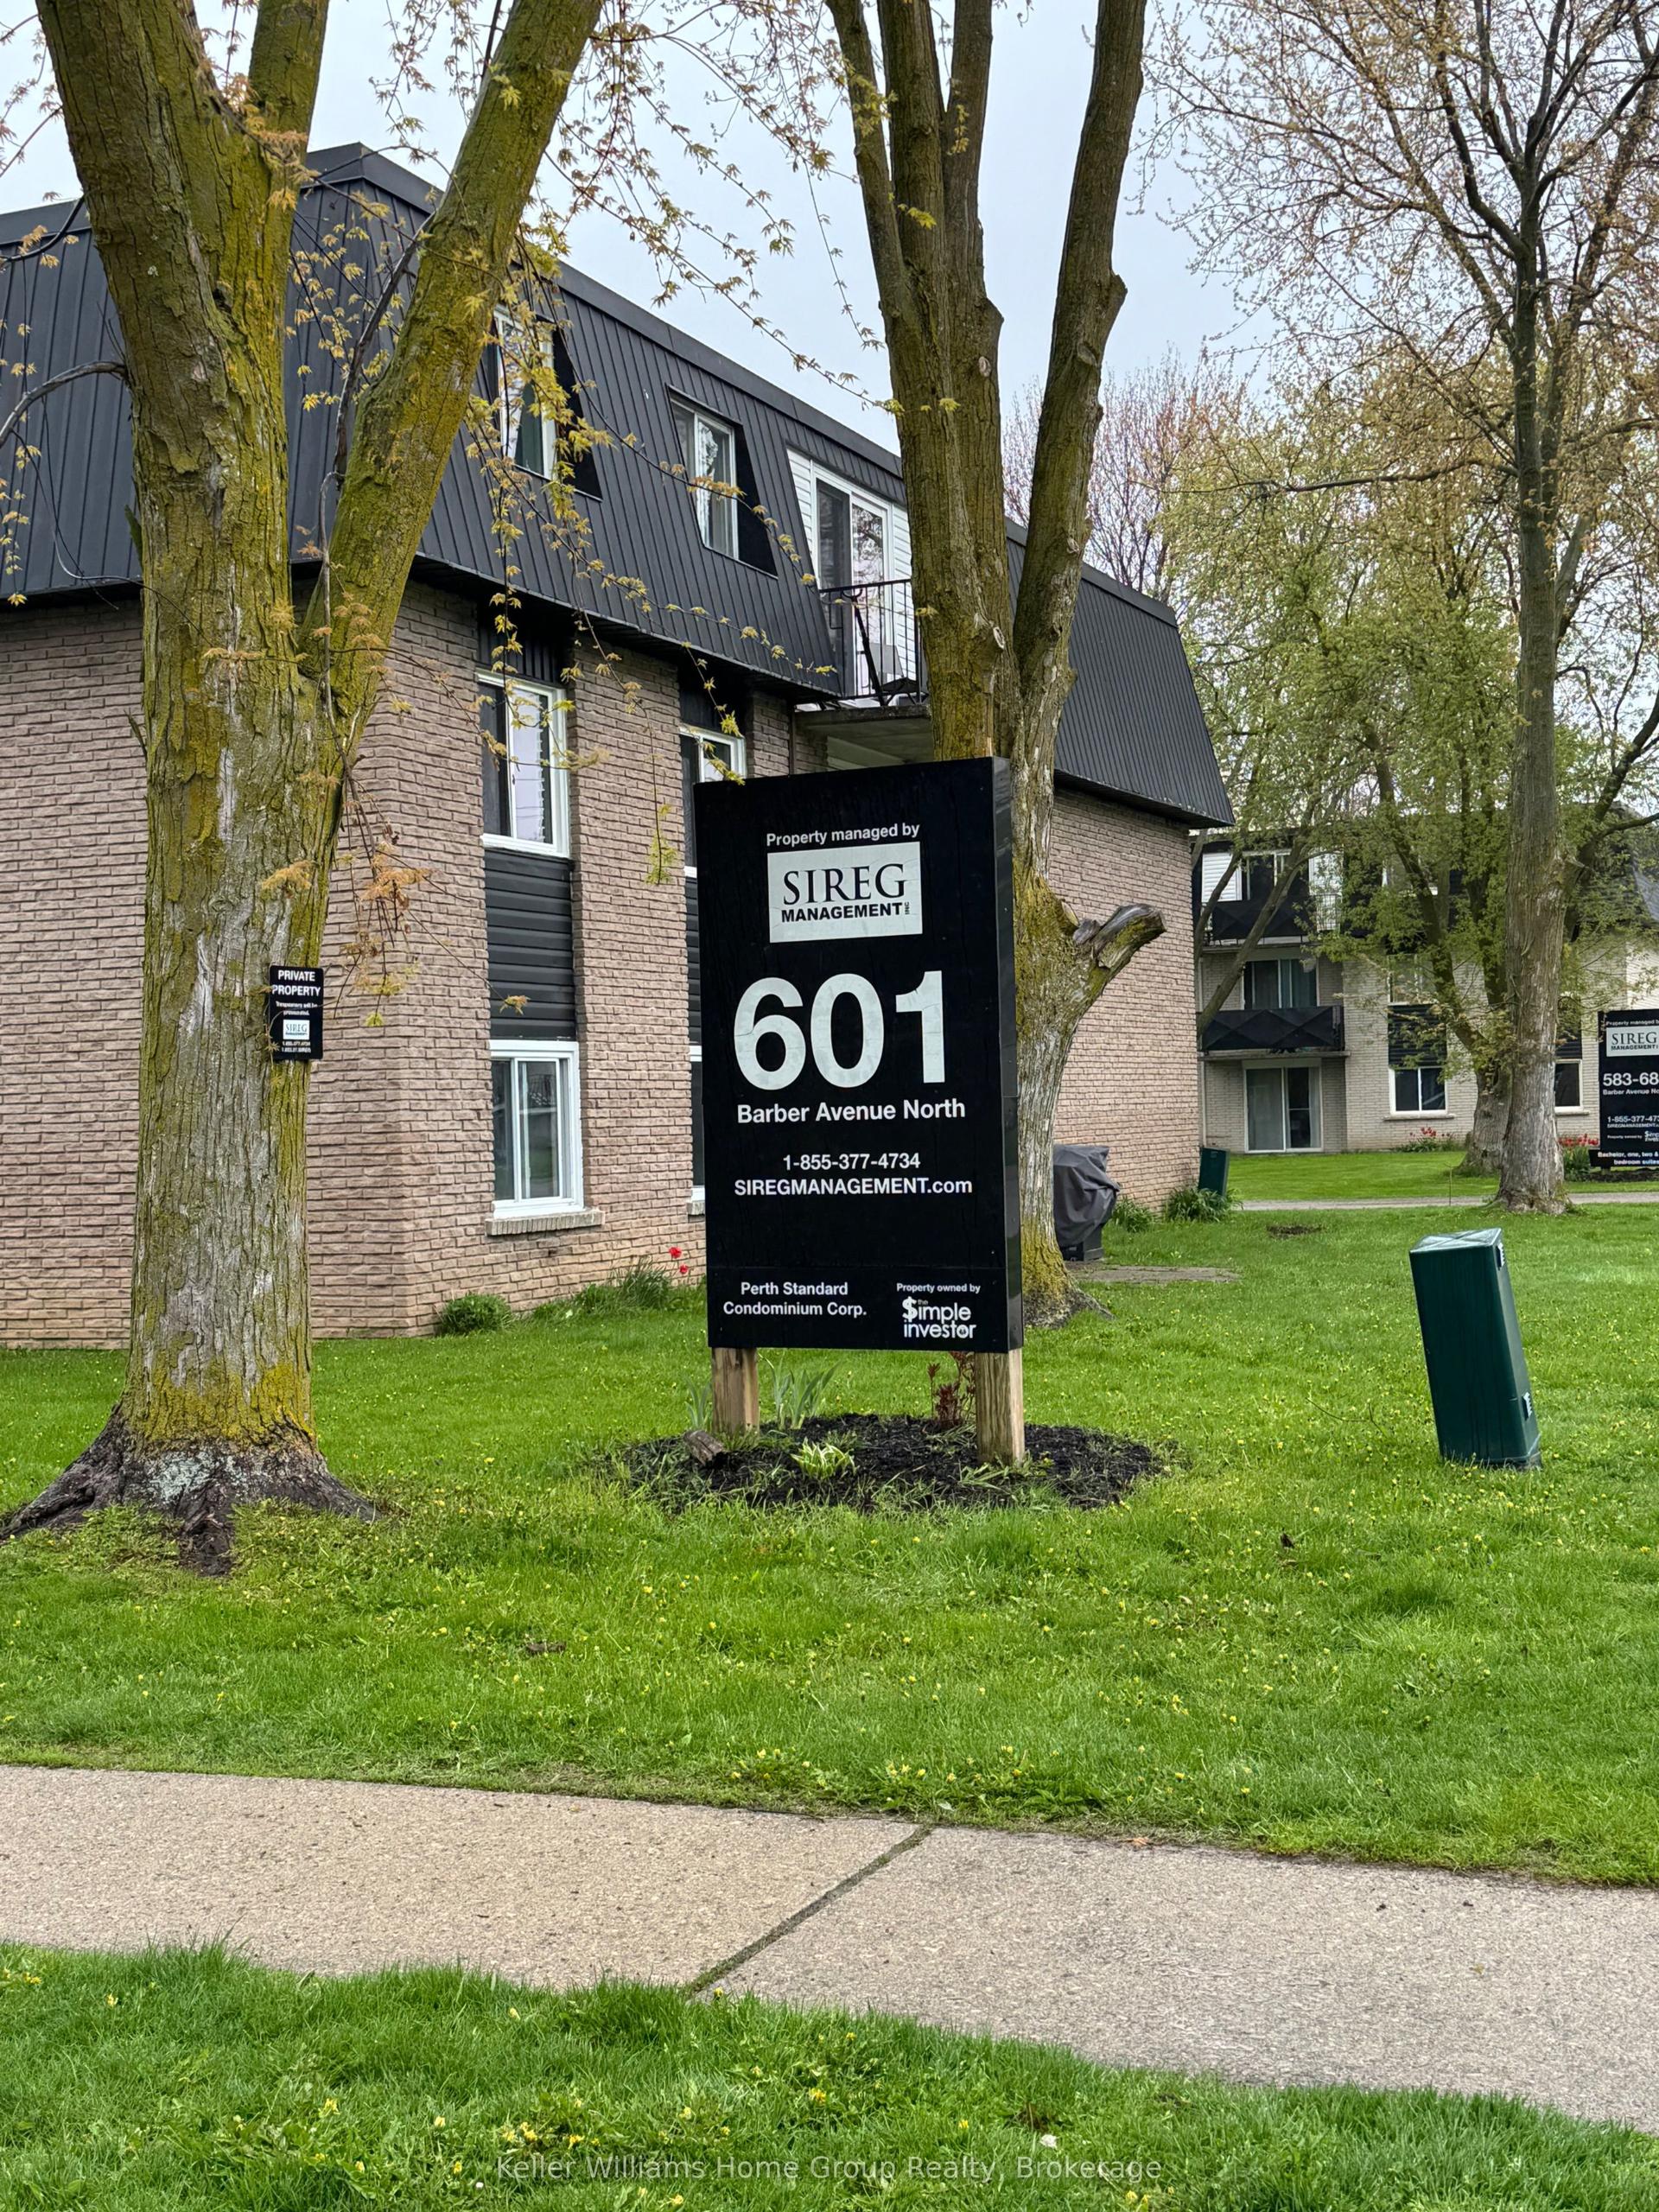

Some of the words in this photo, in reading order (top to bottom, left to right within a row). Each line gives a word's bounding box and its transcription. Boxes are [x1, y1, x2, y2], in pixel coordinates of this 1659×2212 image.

[766, 830, 827, 848] Property
[830, 823, 898, 843] managed
[902, 822, 920, 839] by
[783, 863, 906, 905] SIREG
[781, 902, 902, 922] MANAGEMENT
[277, 969, 315, 982] PRIVATE
[271, 984, 321, 996] PROPERTY
[285, 1023, 308, 1033] SIREG
[734, 970, 945, 1090] 601
[1611, 1031, 1657, 1046] SIREG
[737, 1103, 810, 1124] Barber
[815, 1102, 897, 1122] Avenue
[903, 1097, 966, 1120] North
[783, 1153, 921, 1171] 1-855-377-4734
[734, 1177, 973, 1196] SIREGMANAGEMENT.com
[741, 1282, 779, 1295] Perth
[783, 1282, 849, 1296] Standard
[896, 1282, 935, 1294] Property
[937, 1283, 967, 1293] owned
[969, 1283, 981, 1294] by
[723, 1301, 822, 1316] Condominium
[827, 1302, 867, 1319] Corp.
[903, 1319, 976, 1338] investor
